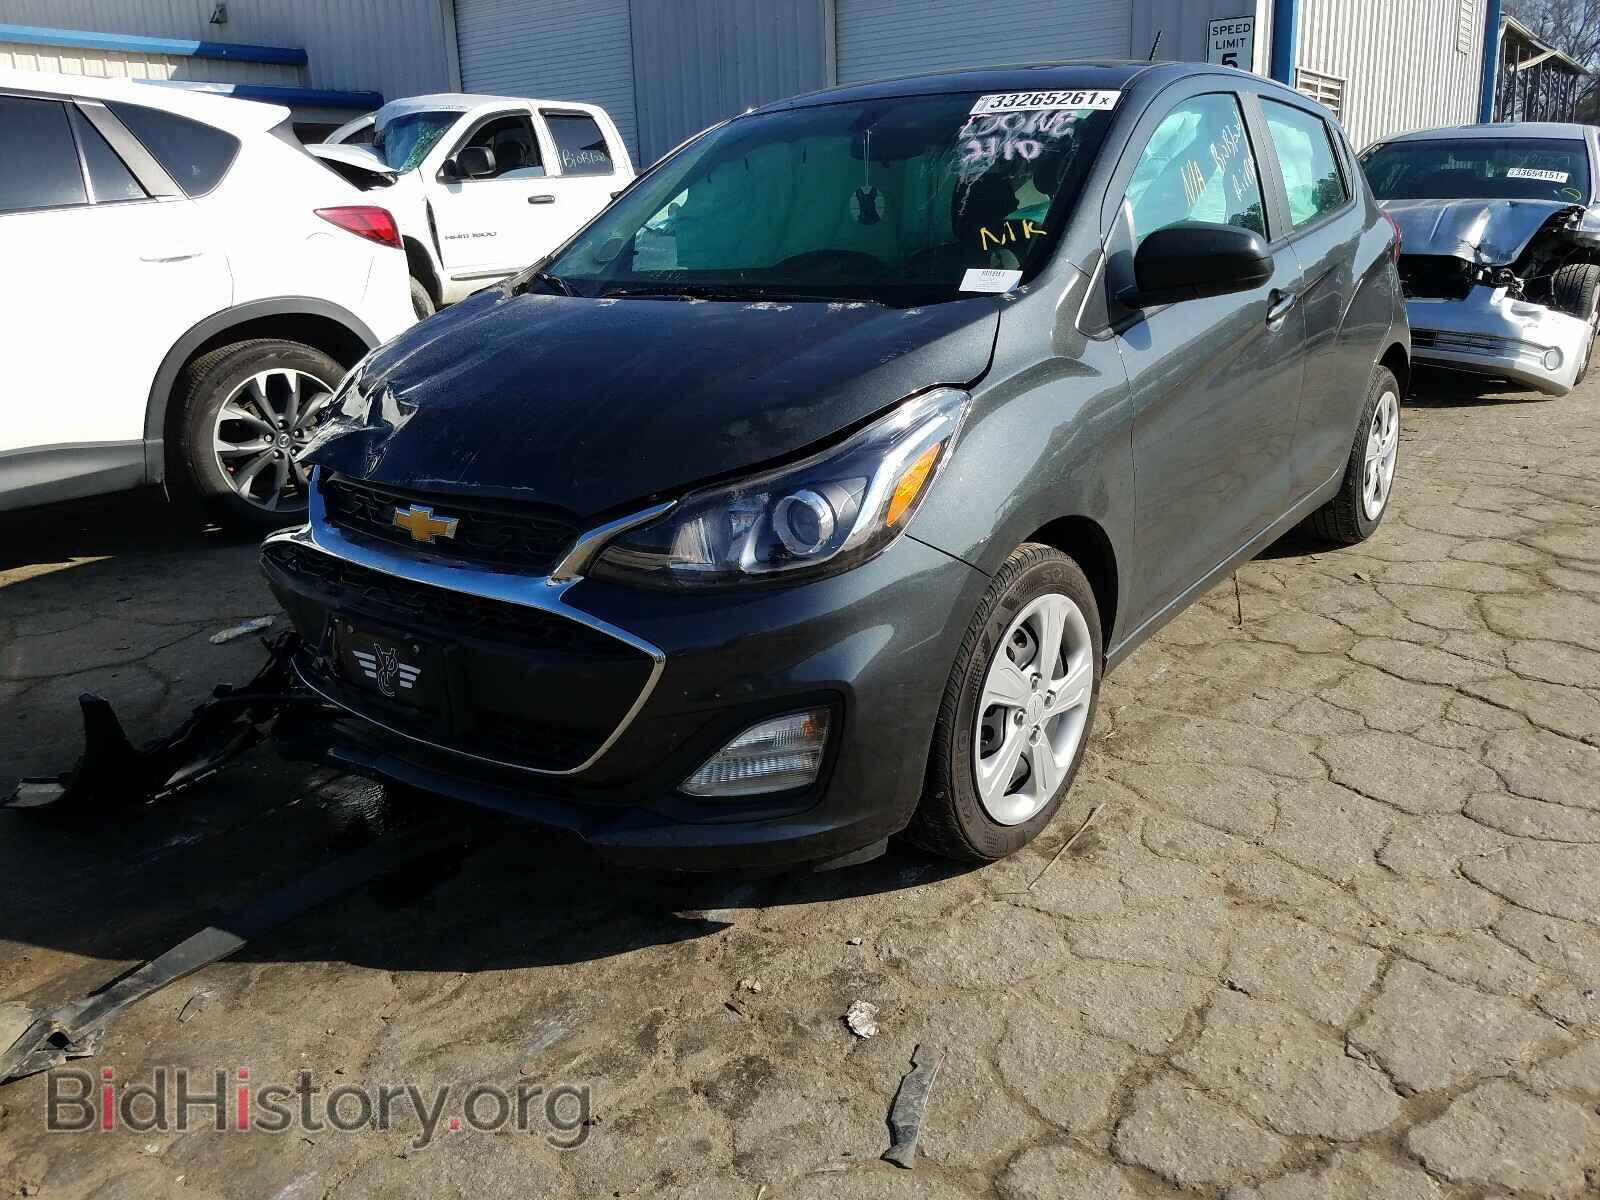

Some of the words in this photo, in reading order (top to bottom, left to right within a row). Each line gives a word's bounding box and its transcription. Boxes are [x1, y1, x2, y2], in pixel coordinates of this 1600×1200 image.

[1212, 23, 1251, 36] SPEED
[1215, 37, 1247, 50] LIMIT
[1221, 52, 1239, 68] 5
[990, 92, 1099, 109] 33265261
